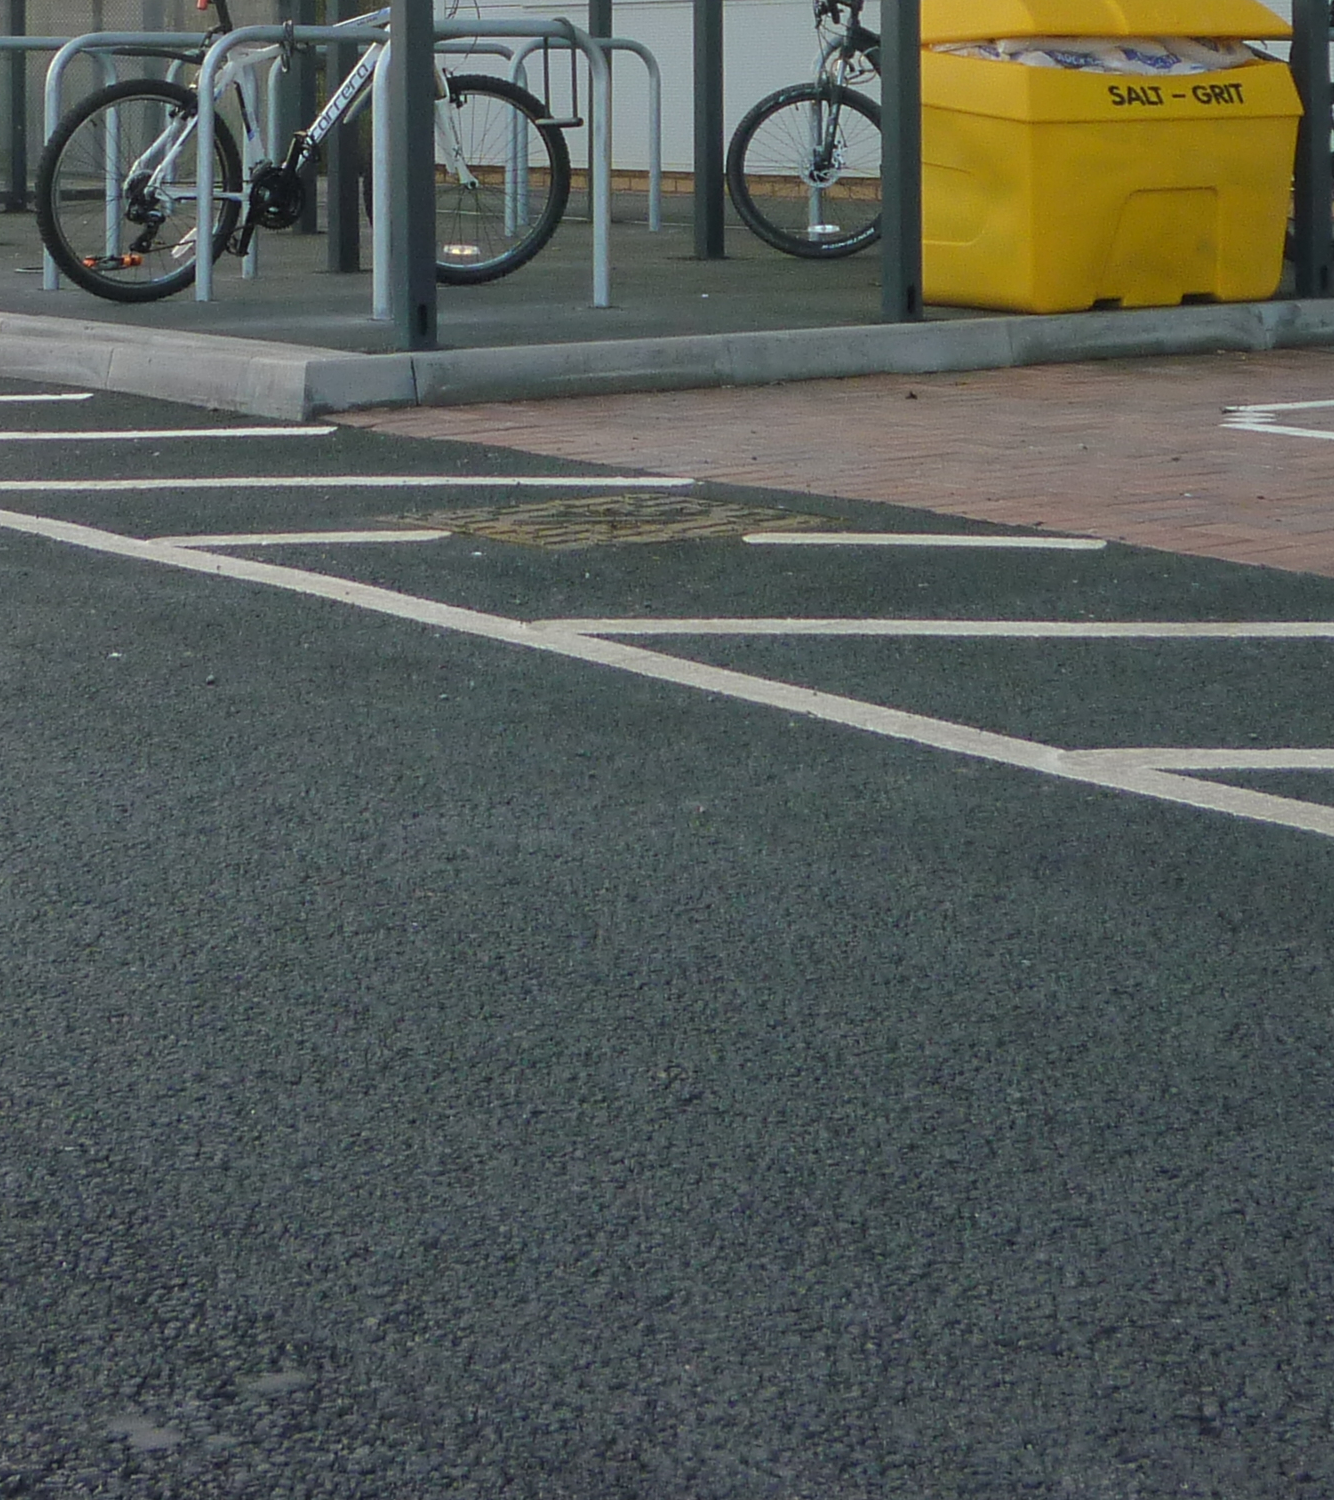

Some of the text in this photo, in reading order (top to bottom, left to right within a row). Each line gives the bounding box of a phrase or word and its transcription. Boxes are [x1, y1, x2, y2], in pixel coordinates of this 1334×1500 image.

[311, 64, 369, 141] carrera
[1108, 85, 1164, 106] SALT
[1192, 83, 1244, 104] GRIT
